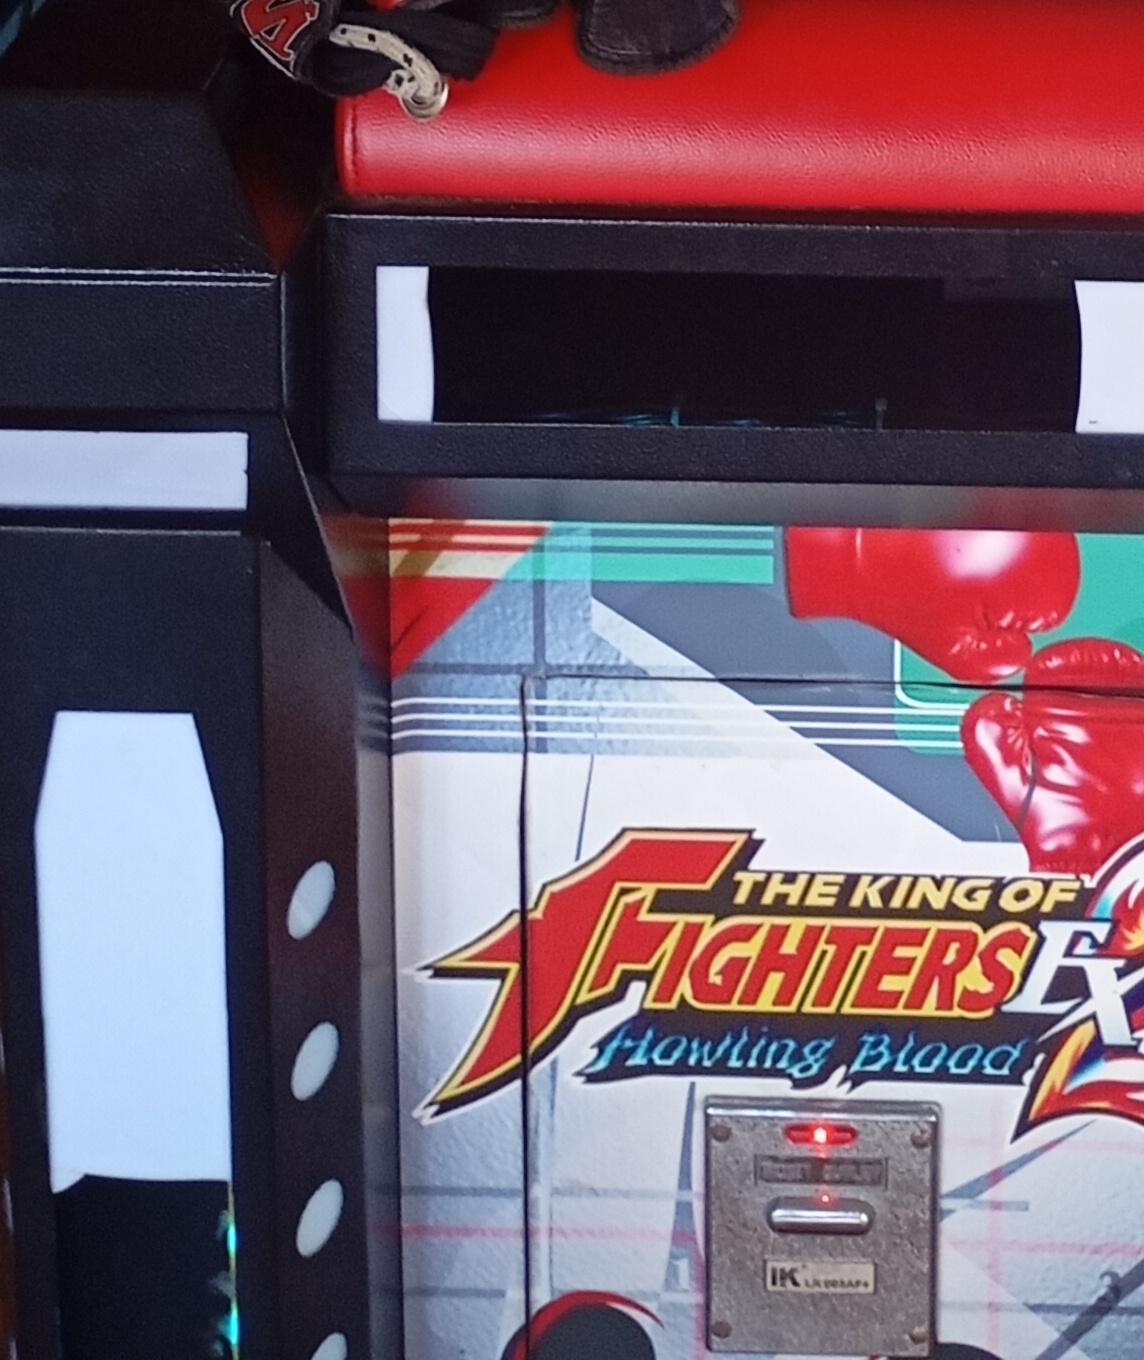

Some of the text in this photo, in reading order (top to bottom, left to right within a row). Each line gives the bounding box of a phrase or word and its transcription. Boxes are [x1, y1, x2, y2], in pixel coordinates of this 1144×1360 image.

[732, 872, 1081, 912] THE KING OF
[585, 1022, 1029, 1079] Howling Blood
